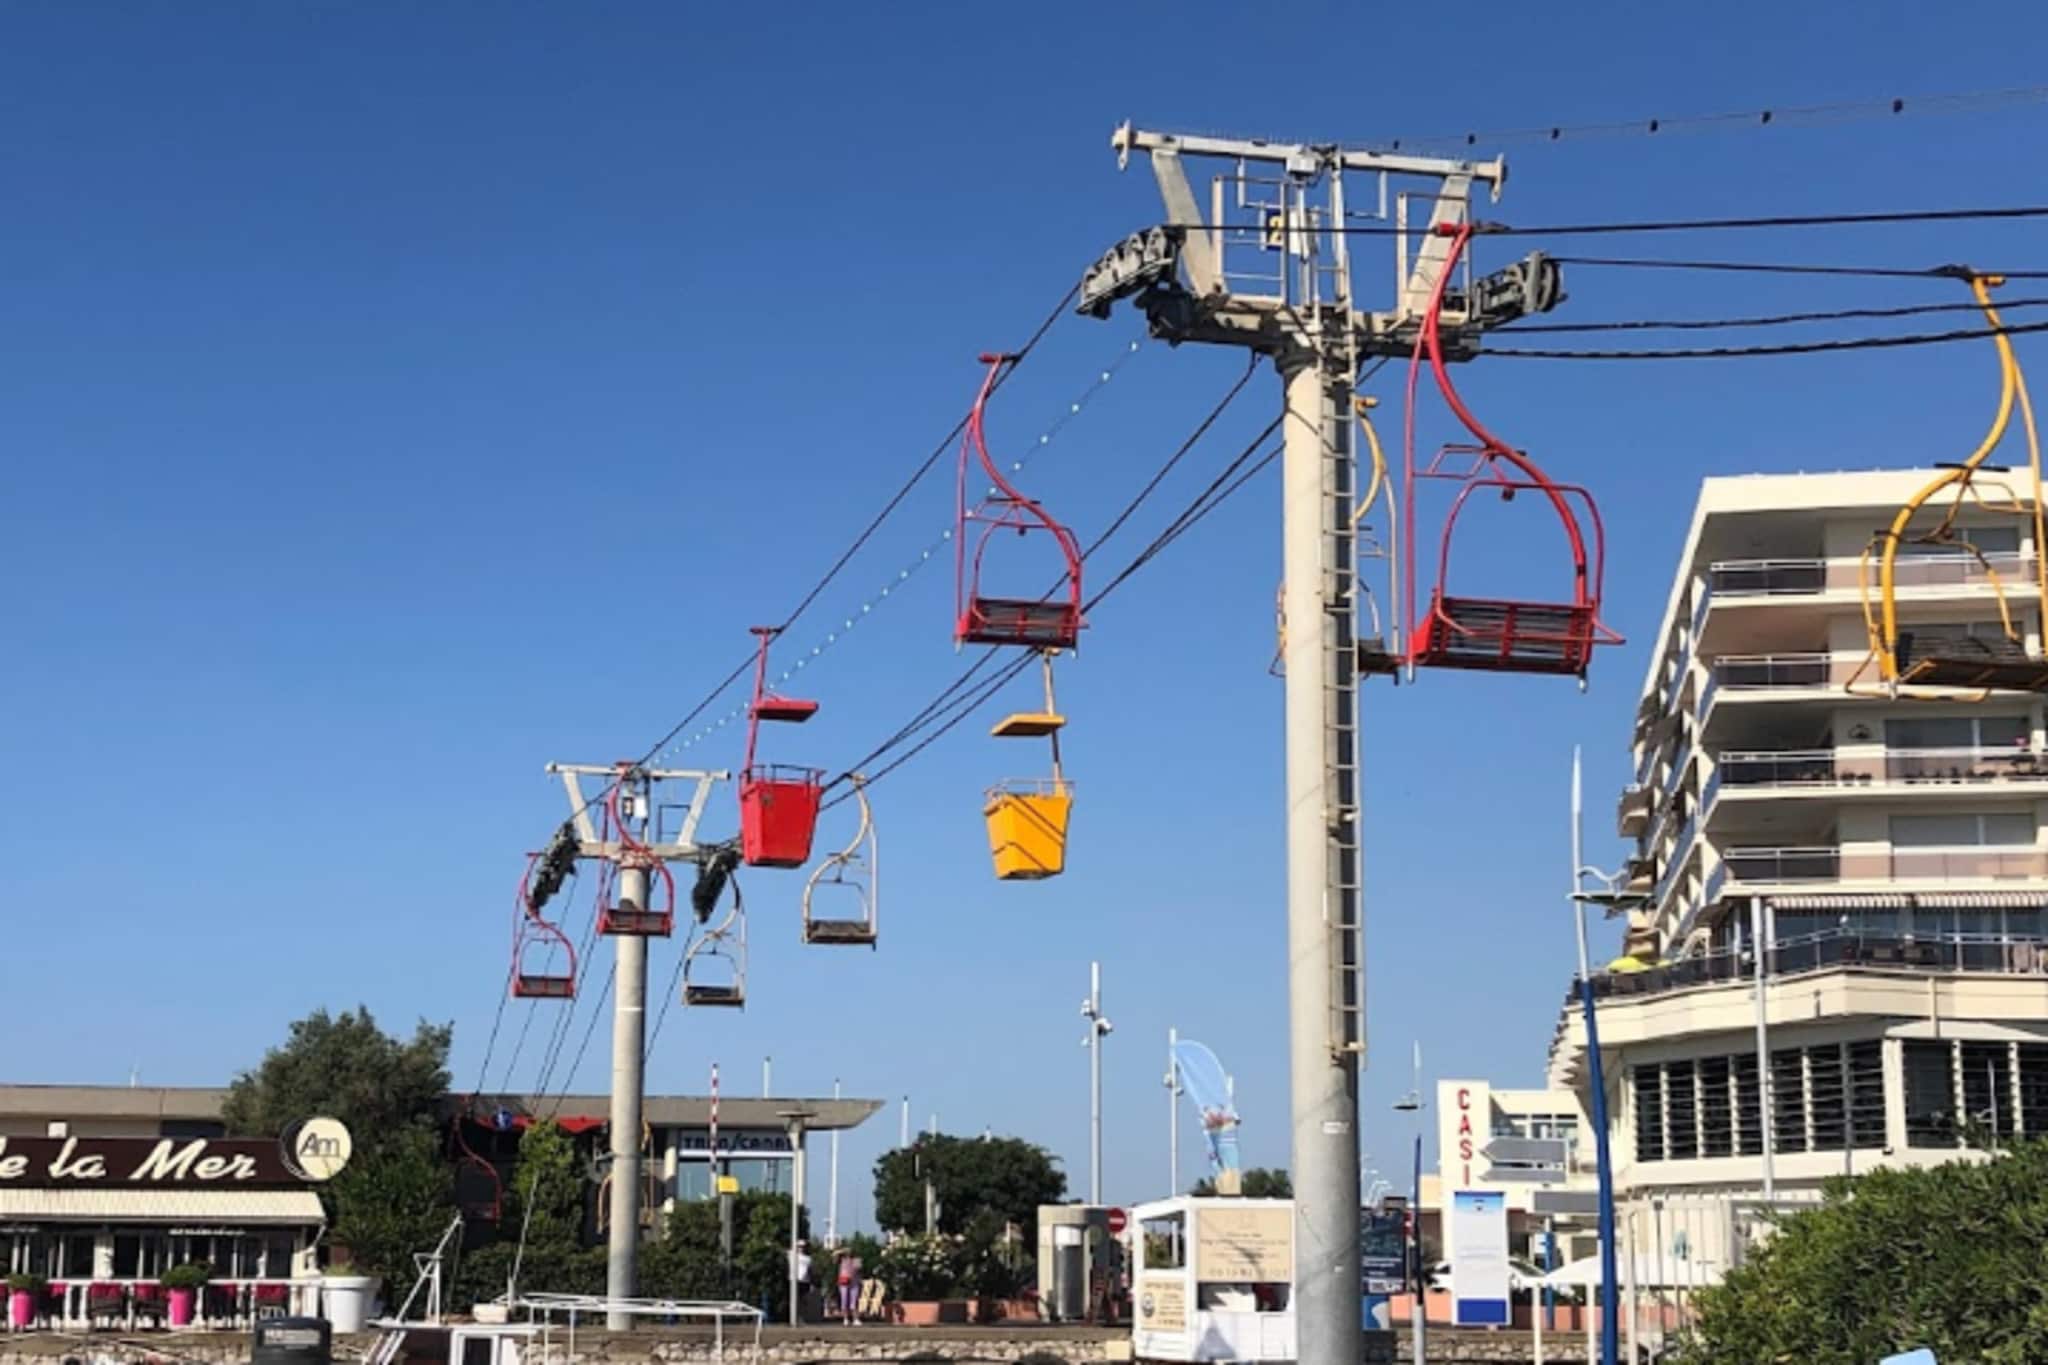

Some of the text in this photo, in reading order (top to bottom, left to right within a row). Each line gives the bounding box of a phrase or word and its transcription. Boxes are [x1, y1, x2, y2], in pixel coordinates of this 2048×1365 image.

[0, 1137, 29, 1178] e
[48, 1136, 106, 1178] la
[128, 1139, 256, 1180] Mer
